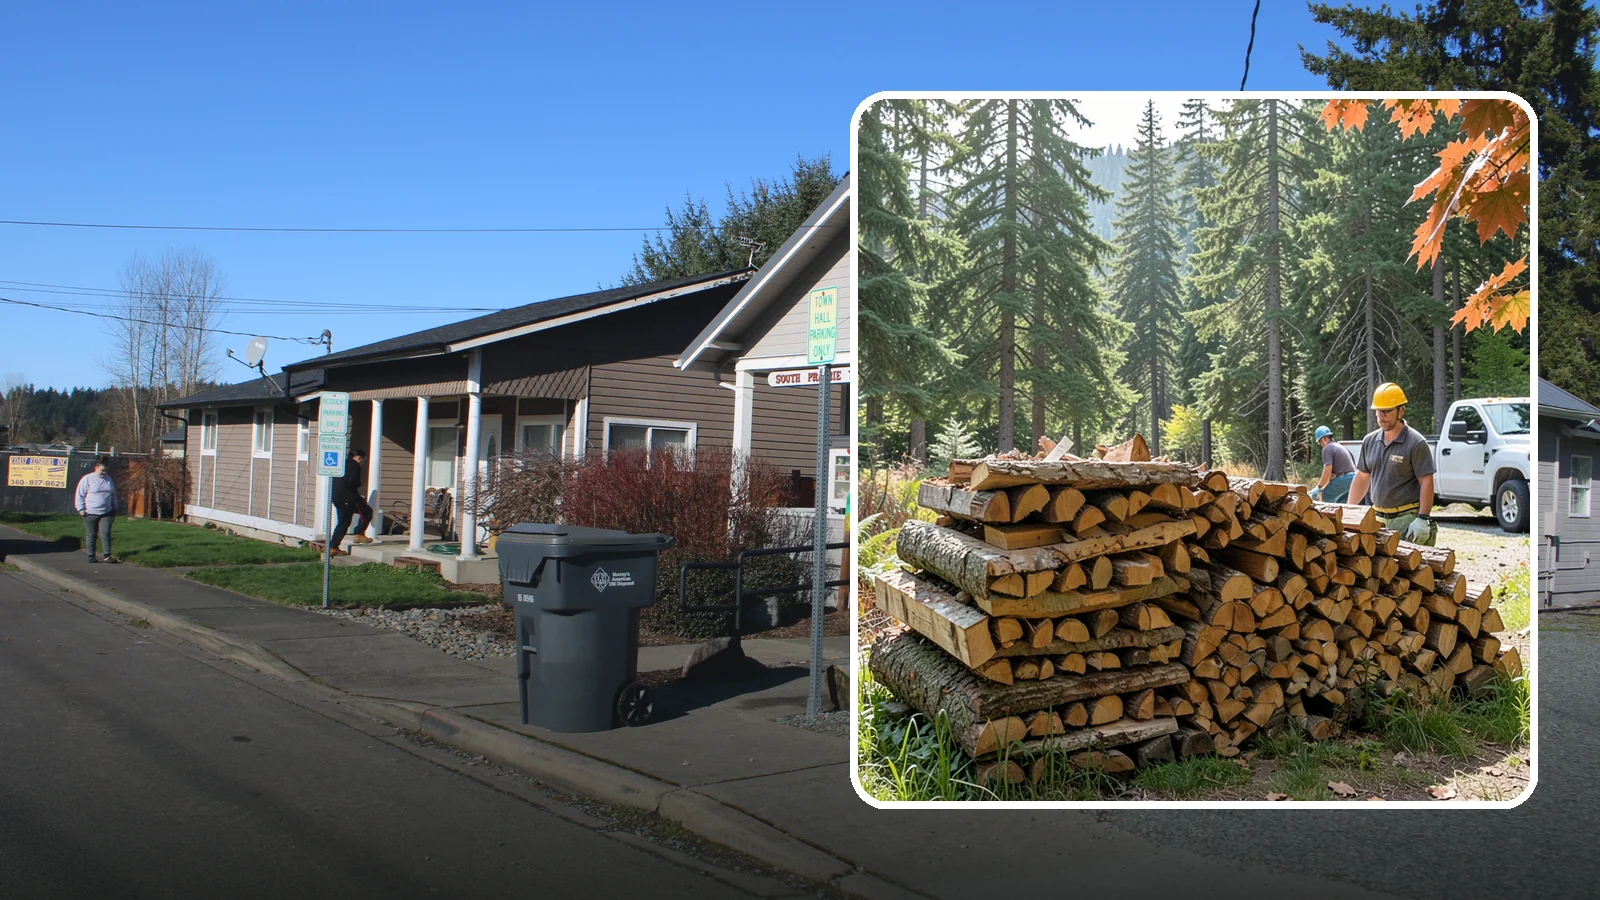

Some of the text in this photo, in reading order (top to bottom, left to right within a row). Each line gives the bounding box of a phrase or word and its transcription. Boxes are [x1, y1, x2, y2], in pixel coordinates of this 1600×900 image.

[815, 295, 833, 308] TOWN
[814, 312, 831, 324] HALL
[810, 327, 836, 340] PARKING
[813, 344, 831, 357] ONLY
[775, 373, 801, 384] SOUTH
[807, 370, 842, 384] PRIE
